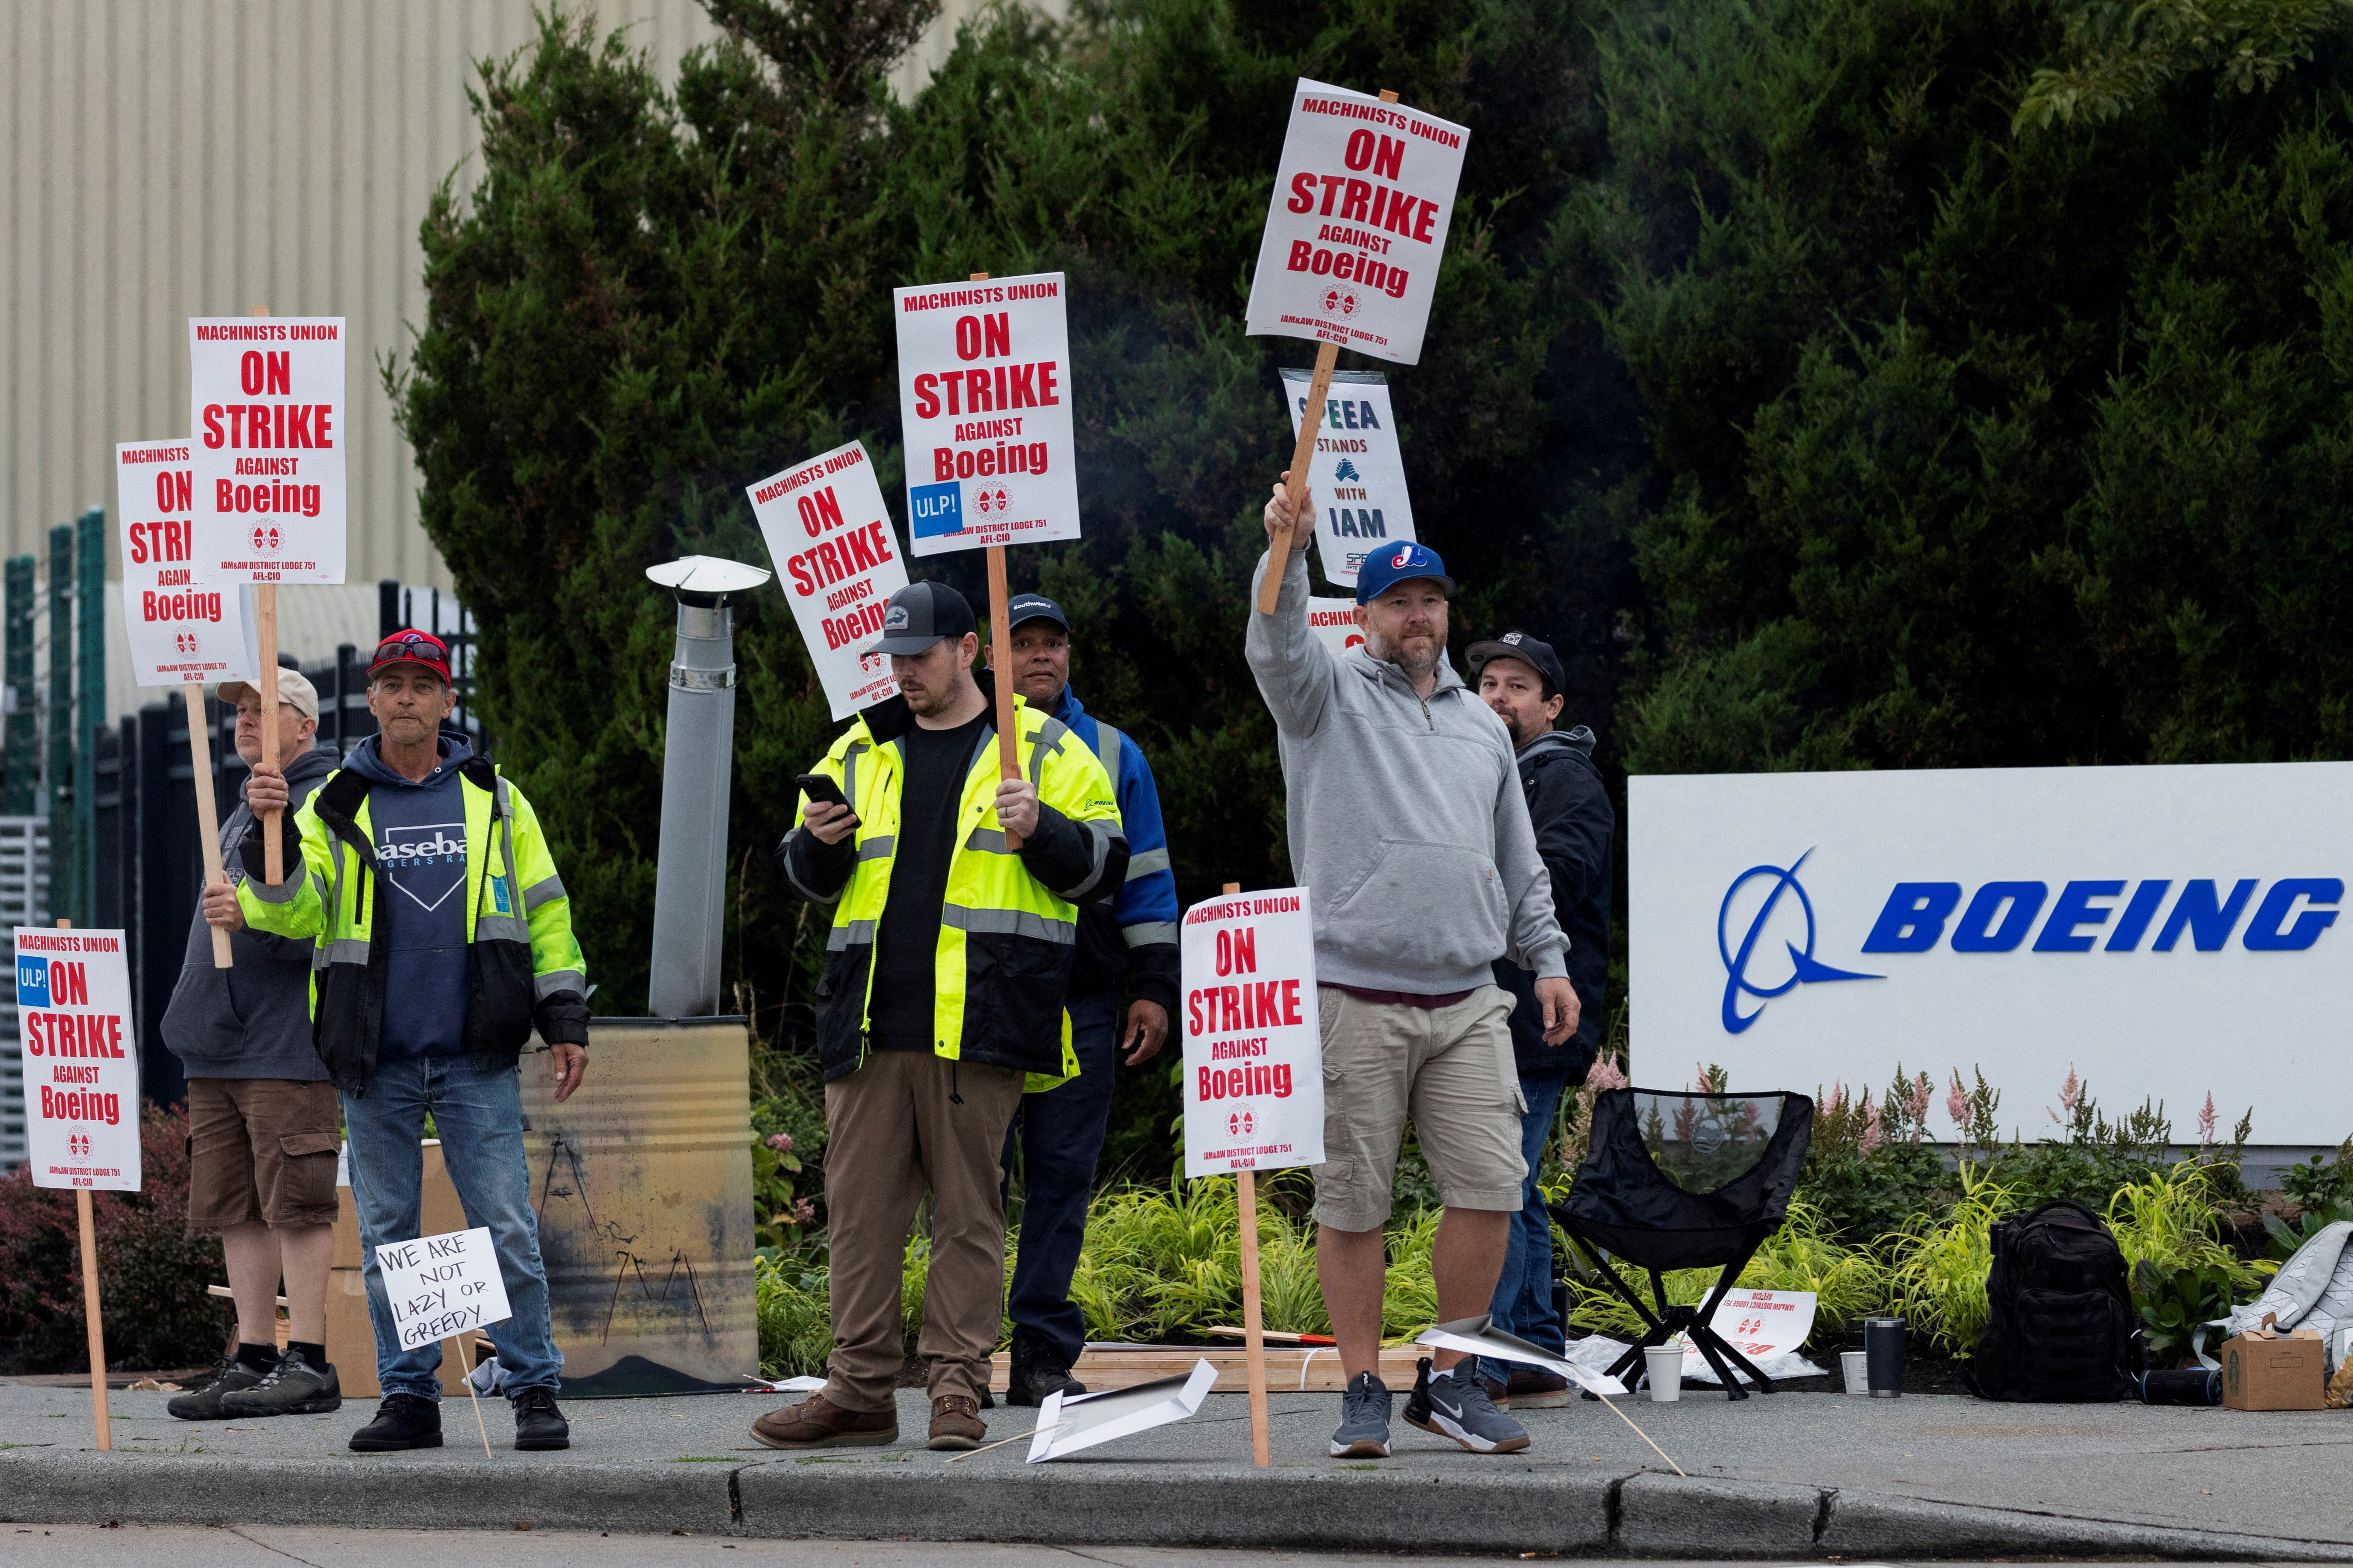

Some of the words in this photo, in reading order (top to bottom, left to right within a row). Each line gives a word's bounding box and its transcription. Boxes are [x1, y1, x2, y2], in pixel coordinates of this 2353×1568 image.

[1302, 98, 1407, 130] MACHINISTS
[1410, 120, 1461, 149] UNION
[1344, 129, 1406, 181] ON
[1287, 172, 1439, 244] STRIKE
[1318, 224, 1392, 254] AGAINST
[1287, 240, 1409, 298] Boeing
[904, 287, 1004, 312] MACHINISTS
[1007, 282, 1058, 301] UNION
[197, 325, 287, 340] MACHINISTS
[290, 325, 338, 340] UNION
[955, 312, 1011, 361] ON
[1281, 315, 1314, 325] IAM&AW
[1314, 320, 1349, 334] DISTRICT
[1350, 329, 1374, 341] LODGE
[1375, 336, 1388, 345] 751
[1316, 330, 1348, 344] AFL-CIO
[241, 350, 290, 396] ON
[914, 361, 1059, 419] STRIKE
[203, 404, 333, 450] STRIKE
[1298, 397, 1381, 429] EEA
[955, 417, 1022, 442] AGAINST
[122, 447, 190, 464] MACHINISTS
[1317, 438, 1367, 453] STANDS
[235, 457, 299, 475] AGAINST
[755, 464, 824, 504] MACHINISTS
[824, 448, 863, 474] UNION
[933, 441, 1048, 482] Boeing
[156, 470, 193, 513] ON
[216, 479, 320, 518] Boeing
[916, 494, 957, 518] ULP!
[1334, 488, 1366, 500] WITH
[797, 485, 844, 538] ON
[975, 523, 1009, 533] DISTRICT
[1011, 521, 1033, 530] LODGE
[1034, 519, 1046, 527] 751
[1329, 508, 1387, 538] IAM
[129, 520, 192, 564] STRI
[980, 533, 1010, 544] AFL-CIO
[787, 520, 893, 597] STRIKE
[1346, 553, 1369, 563] SPE
[158, 569, 191, 586] AGAIN
[252, 572, 281, 580] AFL-CIO
[142, 588, 222, 622] Boeing
[827, 578, 874, 612] AGAINST
[1014, 601, 1047, 610] Southwest
[850, 687, 867, 700] IAM&AW
[866, 677, 889, 692] DISTRICT
[871, 686, 893, 701] AFL-CIO
[374, 832, 466, 861] aseba
[446, 854, 465, 863] RA
[1186, 901, 1251, 925] MACHINISTS
[1254, 896, 1300, 915] UNION
[1860, 878, 2345, 953] BOEING
[19, 935, 81, 952] MACHINISTS
[83, 937, 119, 952] UNION
[1215, 927, 1257, 977] ON
[21, 968, 46, 988] ULP!
[50, 961, 88, 1006] ON
[1188, 979, 1303, 1037] STRIKE
[27, 1012, 125, 1058] STRIKE
[1212, 1037, 1268, 1061] AGAINST
[53, 1065, 100, 1084] AGAINST
[1198, 1061, 1292, 1102] Boeing
[41, 1085, 119, 1125] Boeing
[1204, 1150, 1226, 1160] IAM&AW
[1226, 1147, 1255, 1157] DISTRICT
[1256, 1145, 1278, 1154] LODGE
[1230, 1158, 1255, 1169] AFL-CIO
[69, 1168, 92, 1176] DISTRICT
[72, 1177, 93, 1186] AFL-CIO
[379, 1244, 421, 1271] WE
[427, 1234, 466, 1259] ARE
[420, 1261, 466, 1285] NOT
[394, 1288, 446, 1322] LAZY
[461, 1281, 489, 1296] OR
[404, 1305, 487, 1345] GREEDY.
